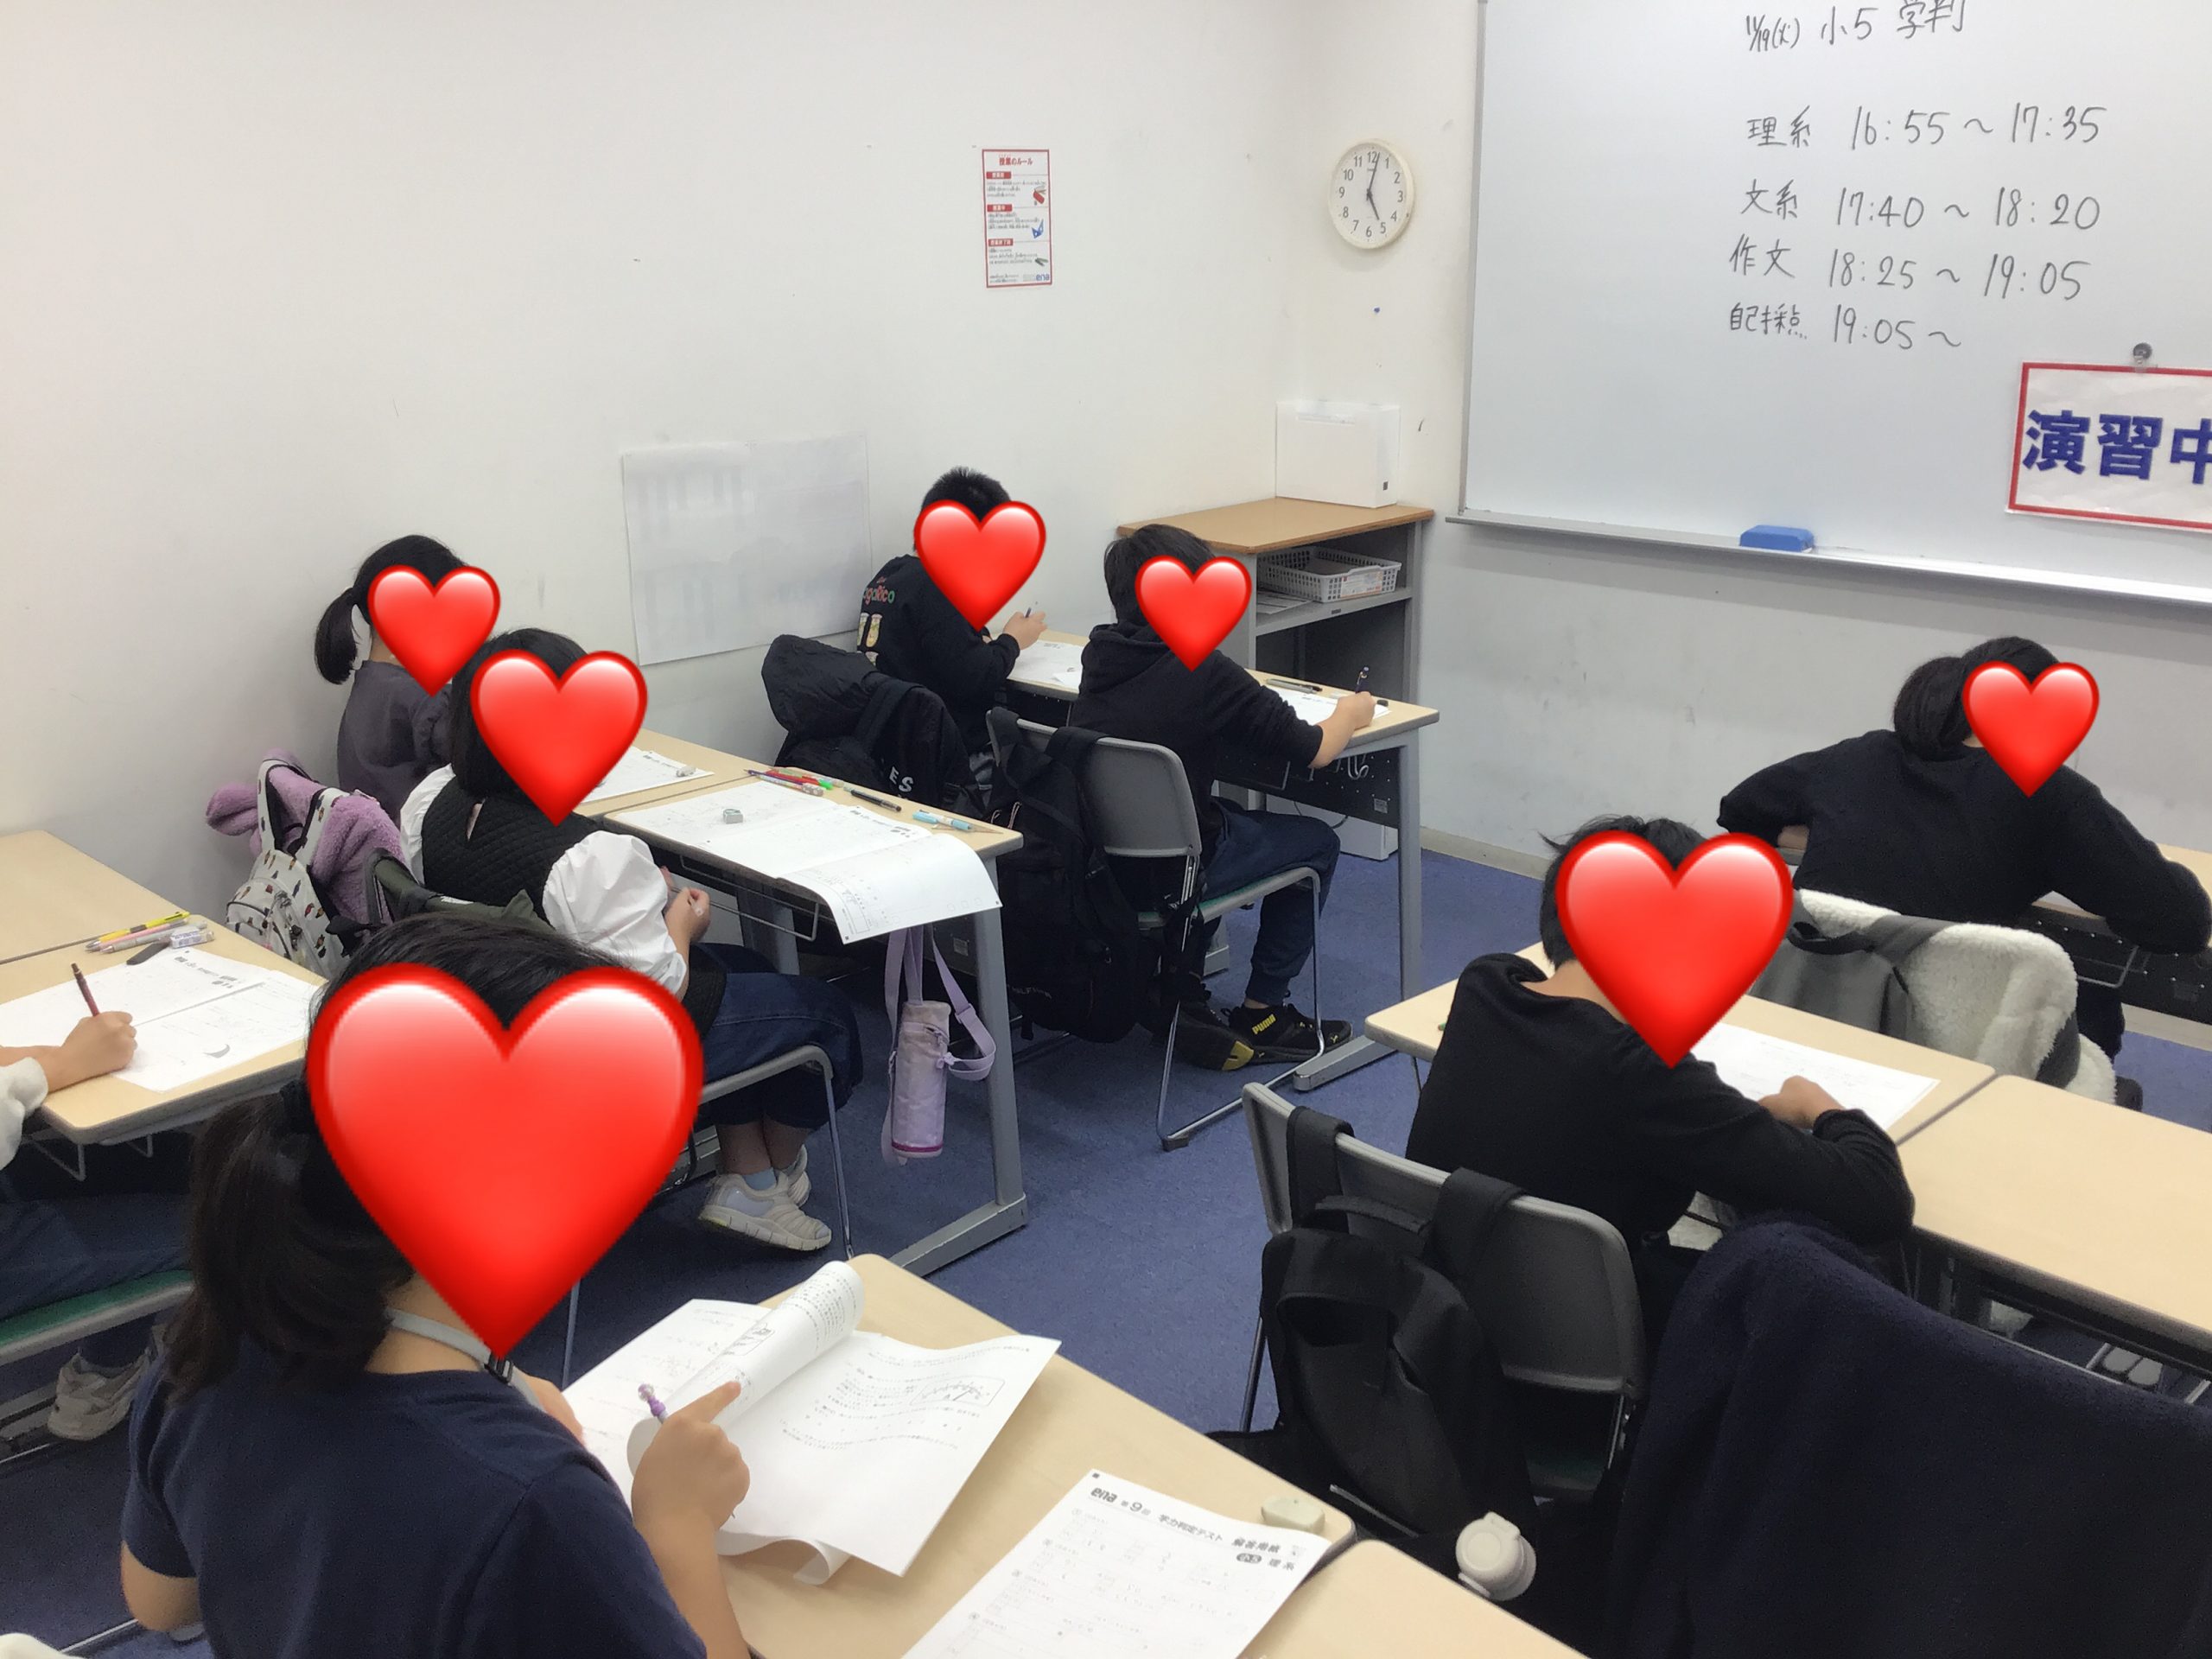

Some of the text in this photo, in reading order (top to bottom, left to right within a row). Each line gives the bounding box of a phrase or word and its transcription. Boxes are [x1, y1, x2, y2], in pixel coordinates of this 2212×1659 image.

[1747, 105, 1812, 148] 理系
[1354, 156, 1363, 168] 11
[1367, 151, 1377, 163] 12
[1385, 157, 1390, 169] 1
[1344, 168, 1354, 181] 10
[1394, 171, 1401, 184] 2
[1338, 186, 1345, 198] 9
[1397, 190, 1404, 203] 3
[1740, 178, 1799, 220] 文系
[1343, 206, 1349, 219] 8
[1390, 210, 1397, 222] 4
[1353, 219, 1359, 232] 7
[1366, 226, 1372, 238] 6
[1380, 222, 1386, 234] 5
[1729, 233, 1796, 279] 作文
[1730, 302, 1808, 339] 自己採点
[2023, 410, 2212, 485] 演習中
[1252, 1014, 1276, 1035] PUMA
[1090, 1487, 1118, 1503] ena
[1159, 1514, 1224, 1542] 学力判定テスト
